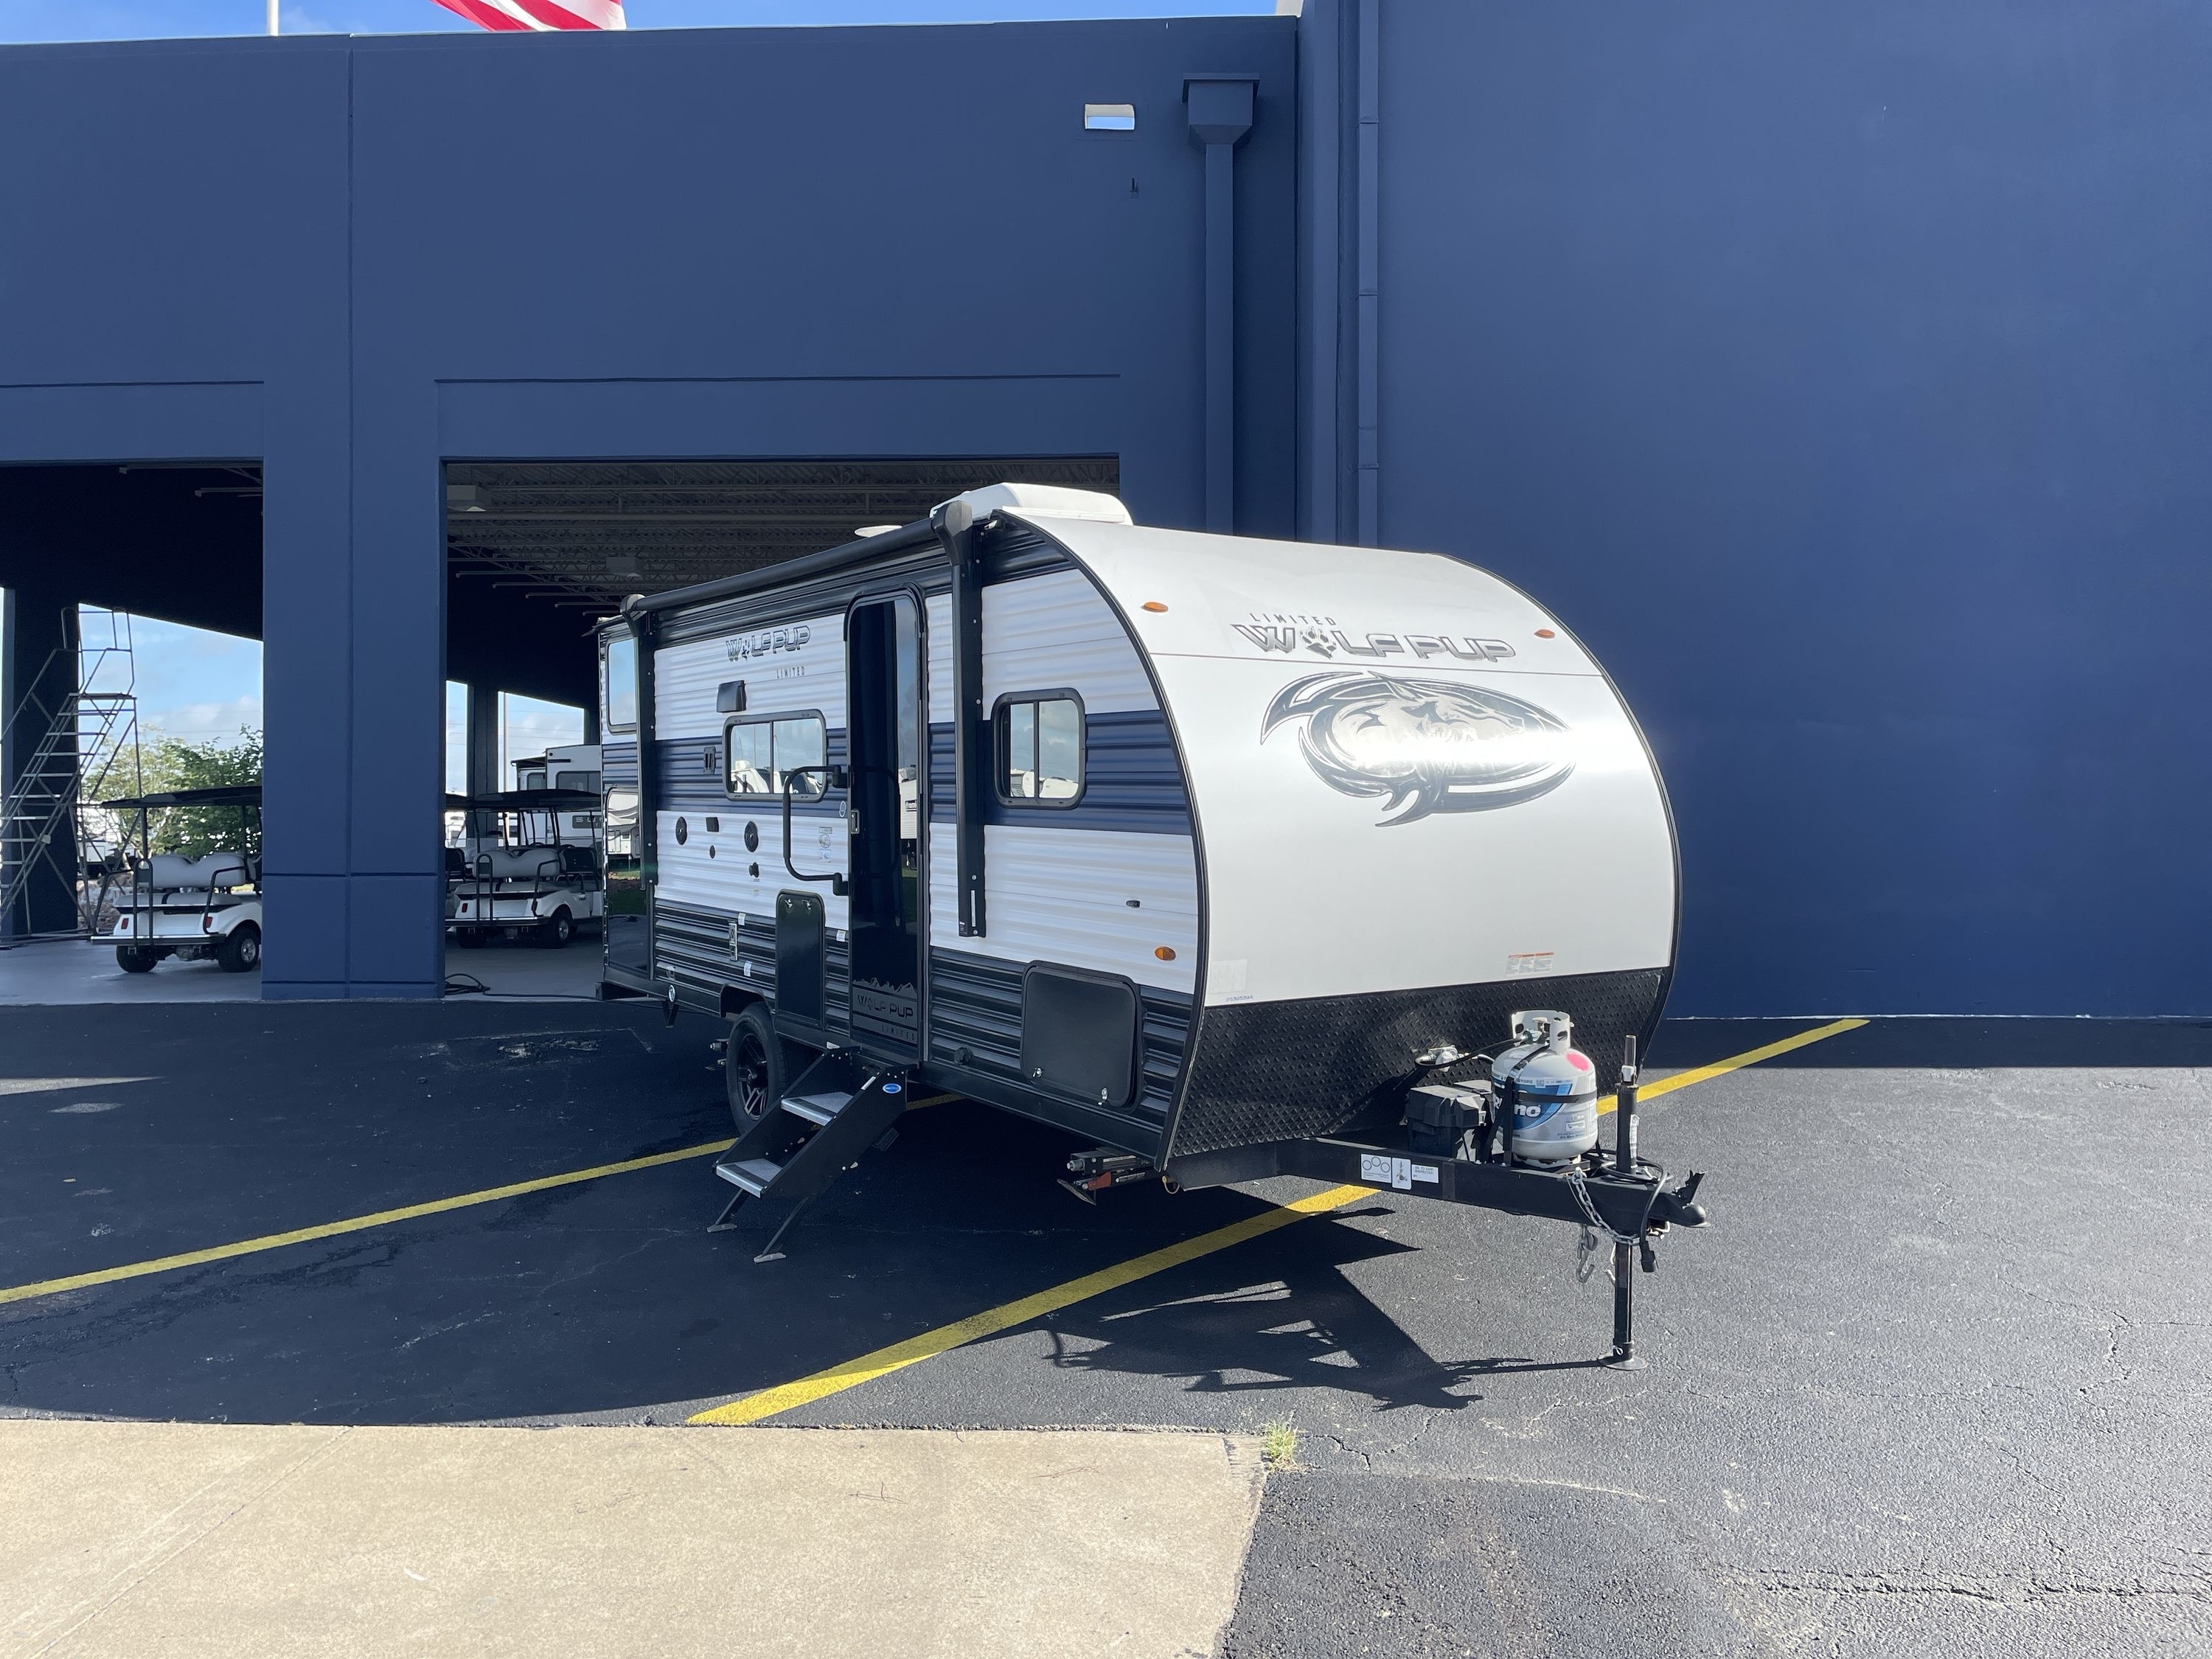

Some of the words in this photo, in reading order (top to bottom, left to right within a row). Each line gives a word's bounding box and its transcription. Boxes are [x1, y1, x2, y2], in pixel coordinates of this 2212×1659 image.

[1249, 613, 1336, 626] LIMITED
[773, 625, 811, 654] PUP
[1404, 635, 1517, 663] PUP
[776, 666, 805, 679] LIMITED
[889, 1003, 914, 1019] PUP
[881, 1025, 915, 1041] LIMITED
